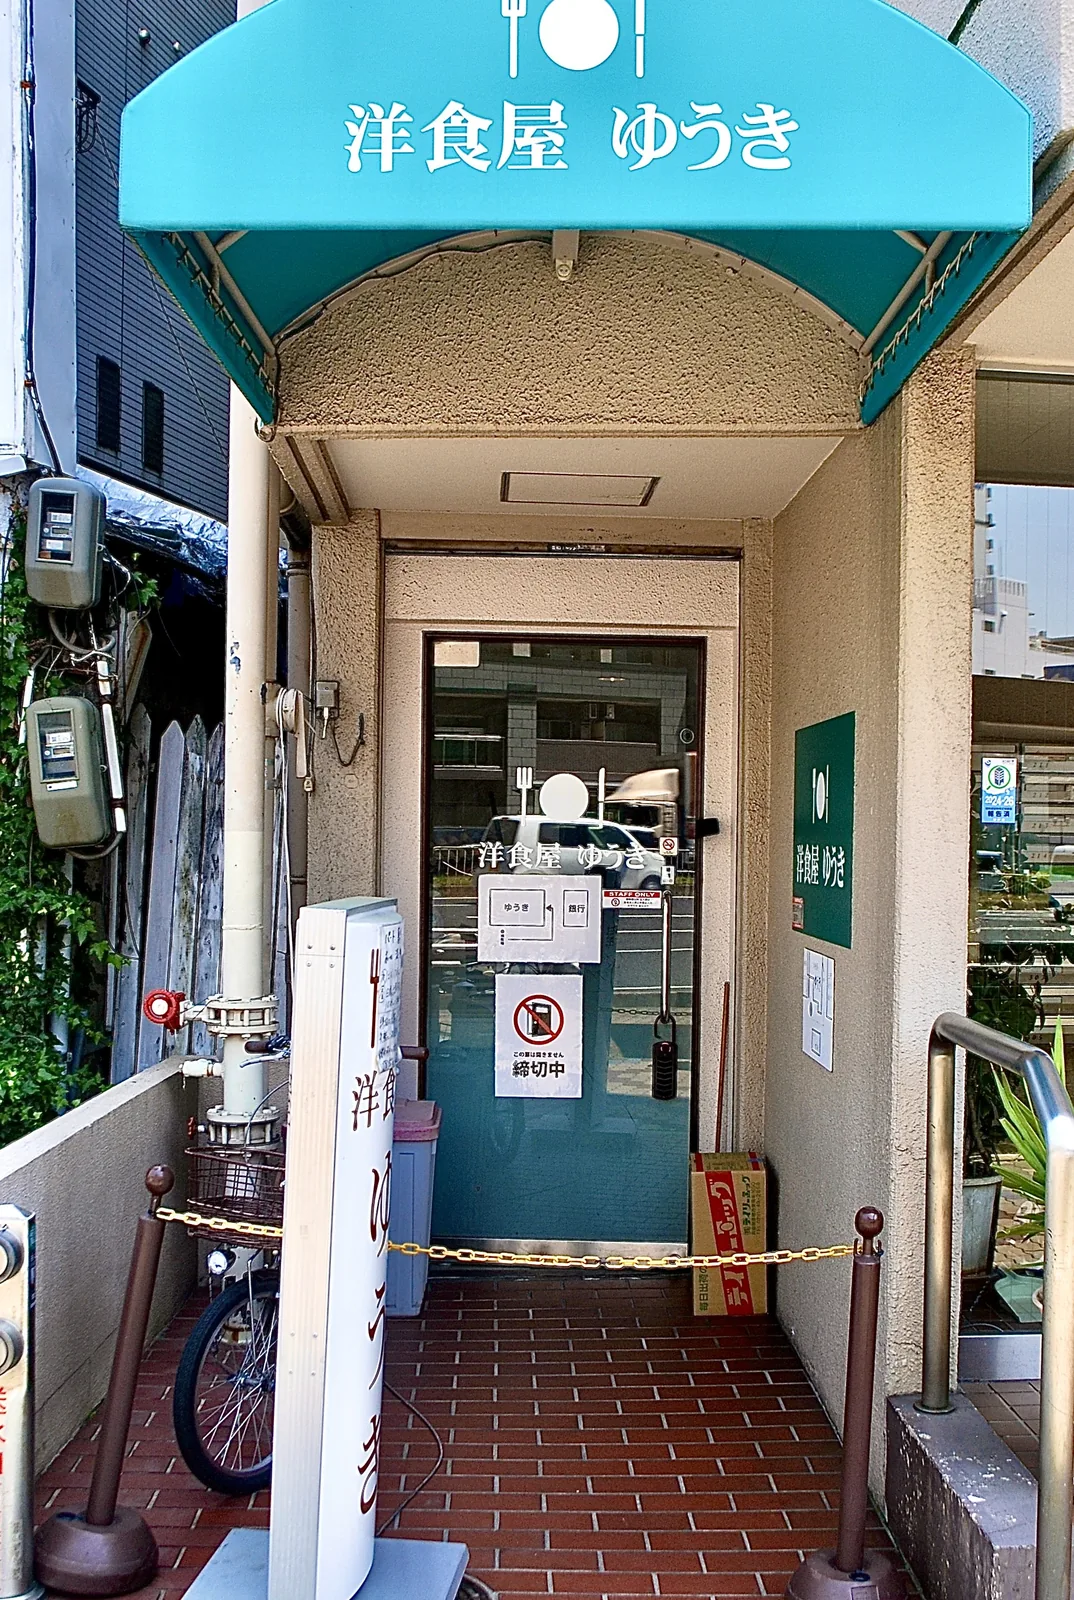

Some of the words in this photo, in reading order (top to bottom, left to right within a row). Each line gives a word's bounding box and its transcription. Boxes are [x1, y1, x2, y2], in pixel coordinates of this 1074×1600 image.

[343, 99, 570, 174] 洋食屋
[611, 100, 801, 172] ゆうき
[478, 841, 562, 869] 洋食屋
[577, 841, 646, 870] ゆうき
[796, 844, 820, 885] 洋食屋
[822, 845, 846, 888] ゆうき
[504, 903, 529, 912] ゆうき
[568, 904, 586, 913] 銀行
[511, 1059, 565, 1079] 締切中
